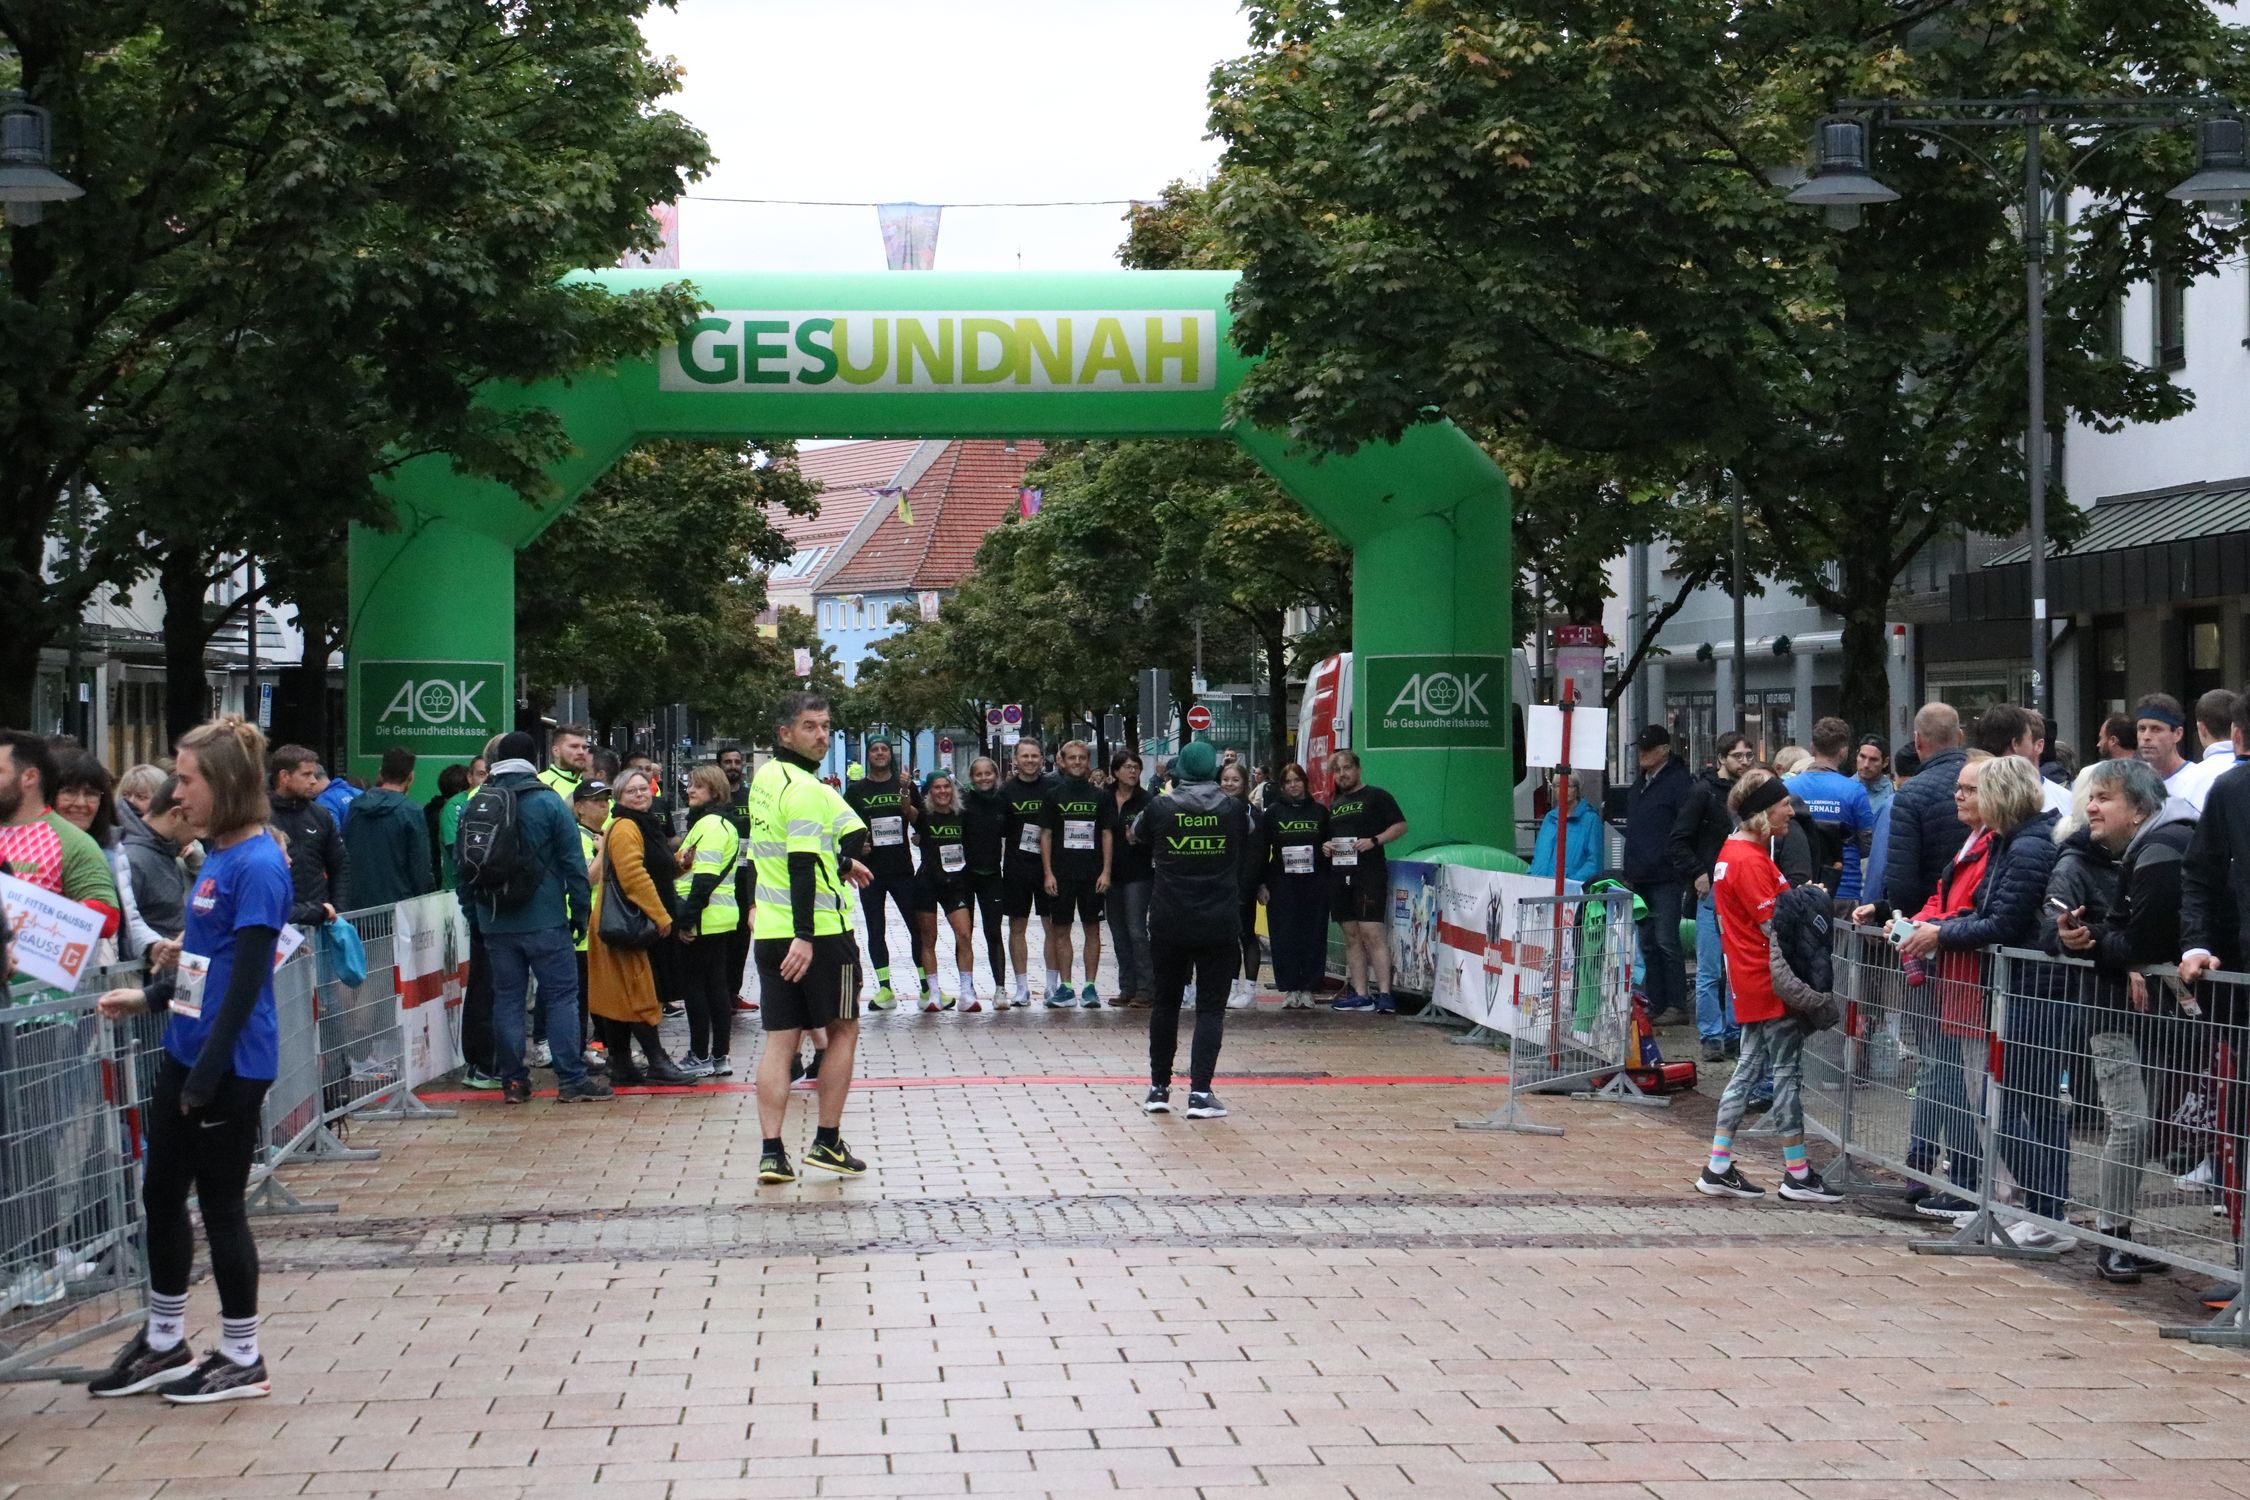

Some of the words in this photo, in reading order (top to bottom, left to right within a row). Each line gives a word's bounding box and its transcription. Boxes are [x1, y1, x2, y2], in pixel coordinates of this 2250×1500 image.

[677, 318, 1199, 385] GESUNDNAH
[1385, 672, 1488, 715] AOK
[379, 679, 487, 723] AOK
[376, 726, 390, 735] Die
[1383, 719, 1397, 728] Die
[1058, 802, 1097, 812] VOLZ
[1174, 813, 1218, 827] Team
[1278, 821, 1319, 830] VOLZ
[1166, 836, 1227, 850] VOLZ
[7, 890, 23, 902] DIE
[24, 897, 55, 916] FITTEN
[56, 911, 94, 932] GAUSSIS
[19, 930, 61, 956] GAUSS
